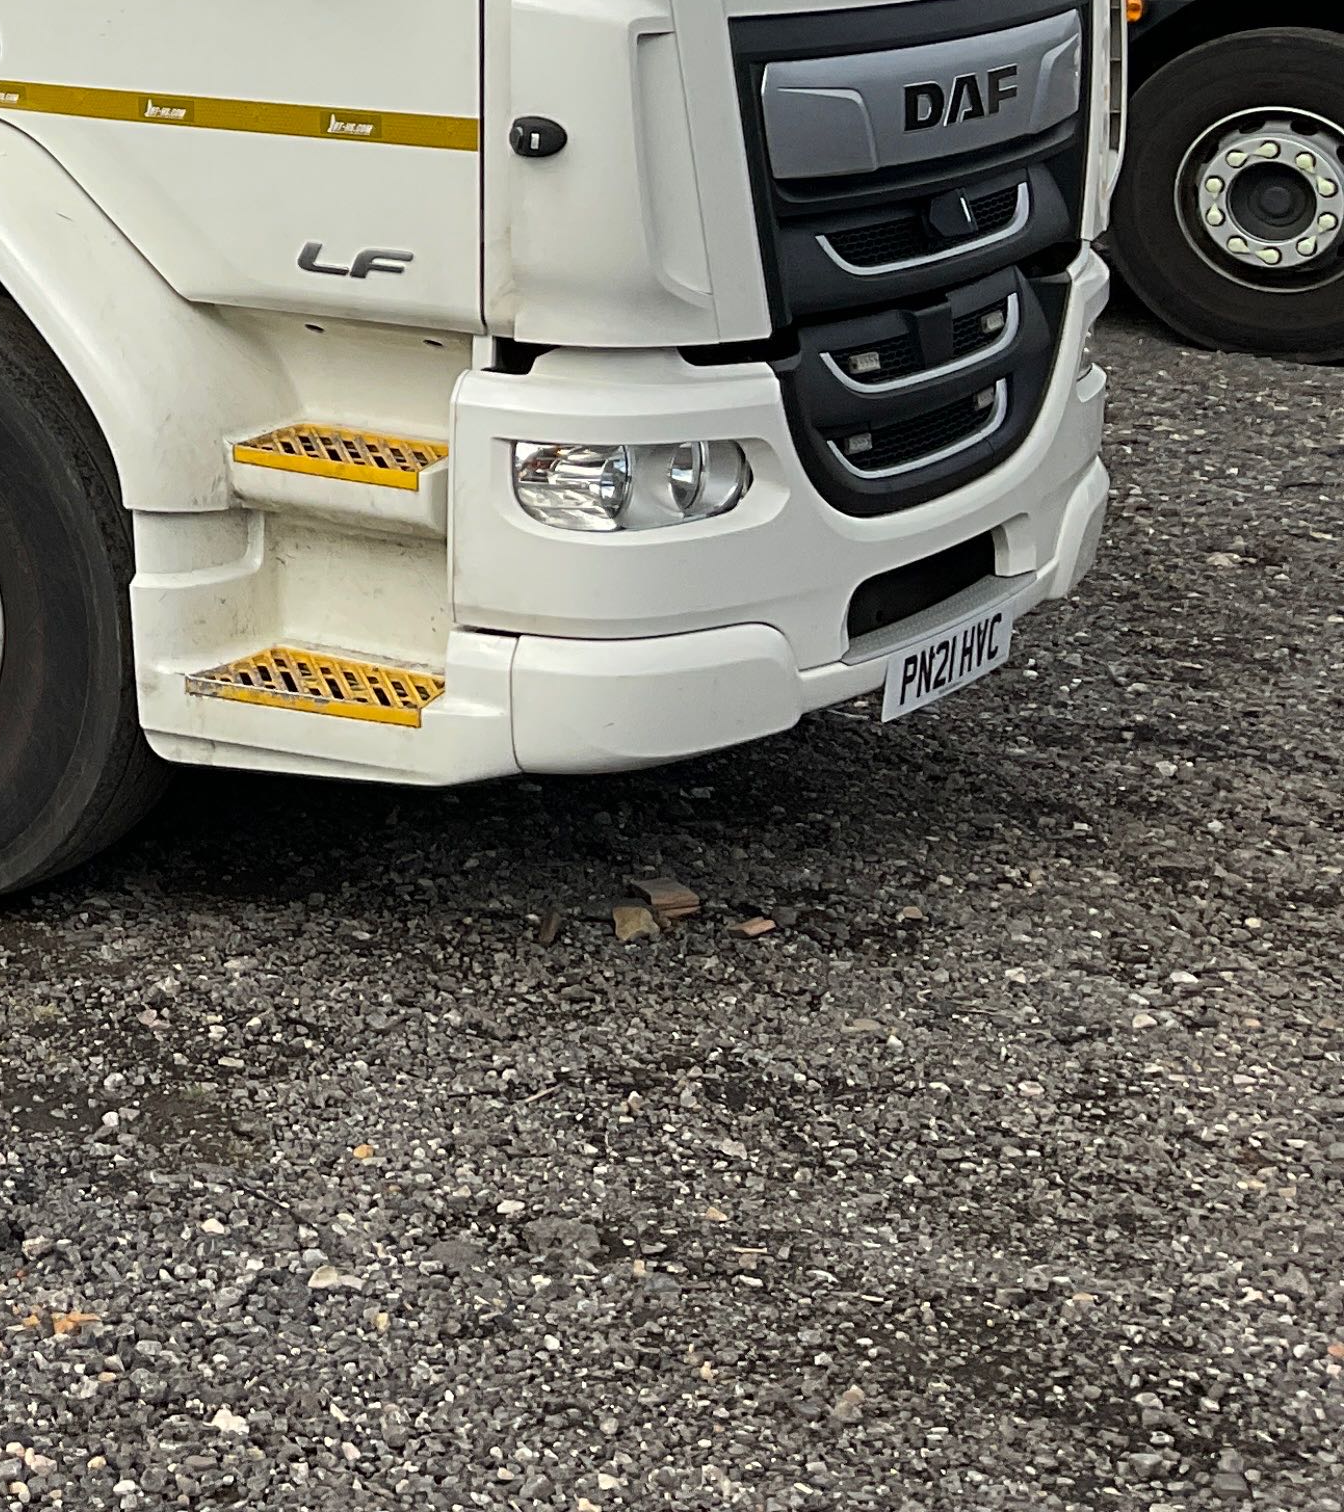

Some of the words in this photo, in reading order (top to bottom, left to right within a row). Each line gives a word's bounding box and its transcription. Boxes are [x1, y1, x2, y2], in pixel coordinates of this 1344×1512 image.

[903, 64, 1018, 134] DAF
[297, 241, 414, 279] LF
[899, 636, 957, 705] PN21
[959, 613, 1002, 676] HVC
